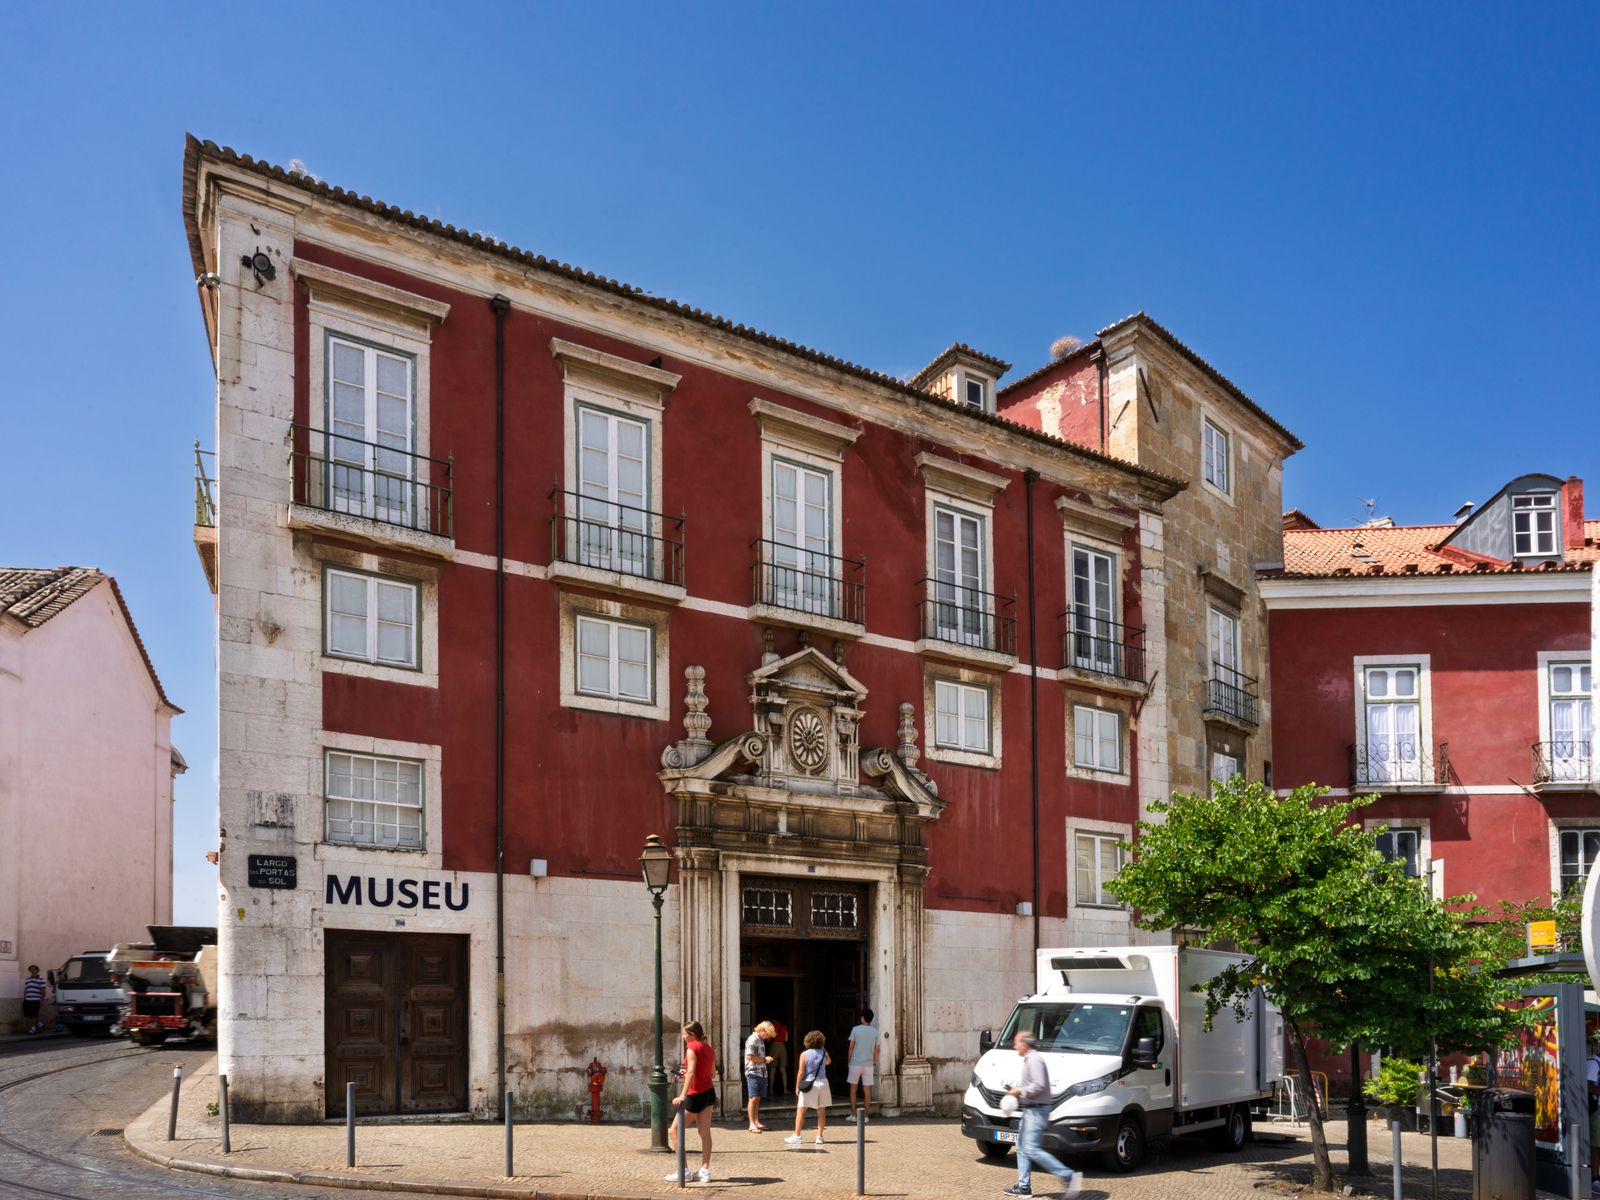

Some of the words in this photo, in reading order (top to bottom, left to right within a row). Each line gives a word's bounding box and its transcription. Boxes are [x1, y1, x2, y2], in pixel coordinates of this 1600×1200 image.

[256, 859, 288, 867] LARGO
[259, 868, 296, 877] PORTAS
[268, 877, 287, 885] SOL
[325, 874, 469, 911] MUSEU
